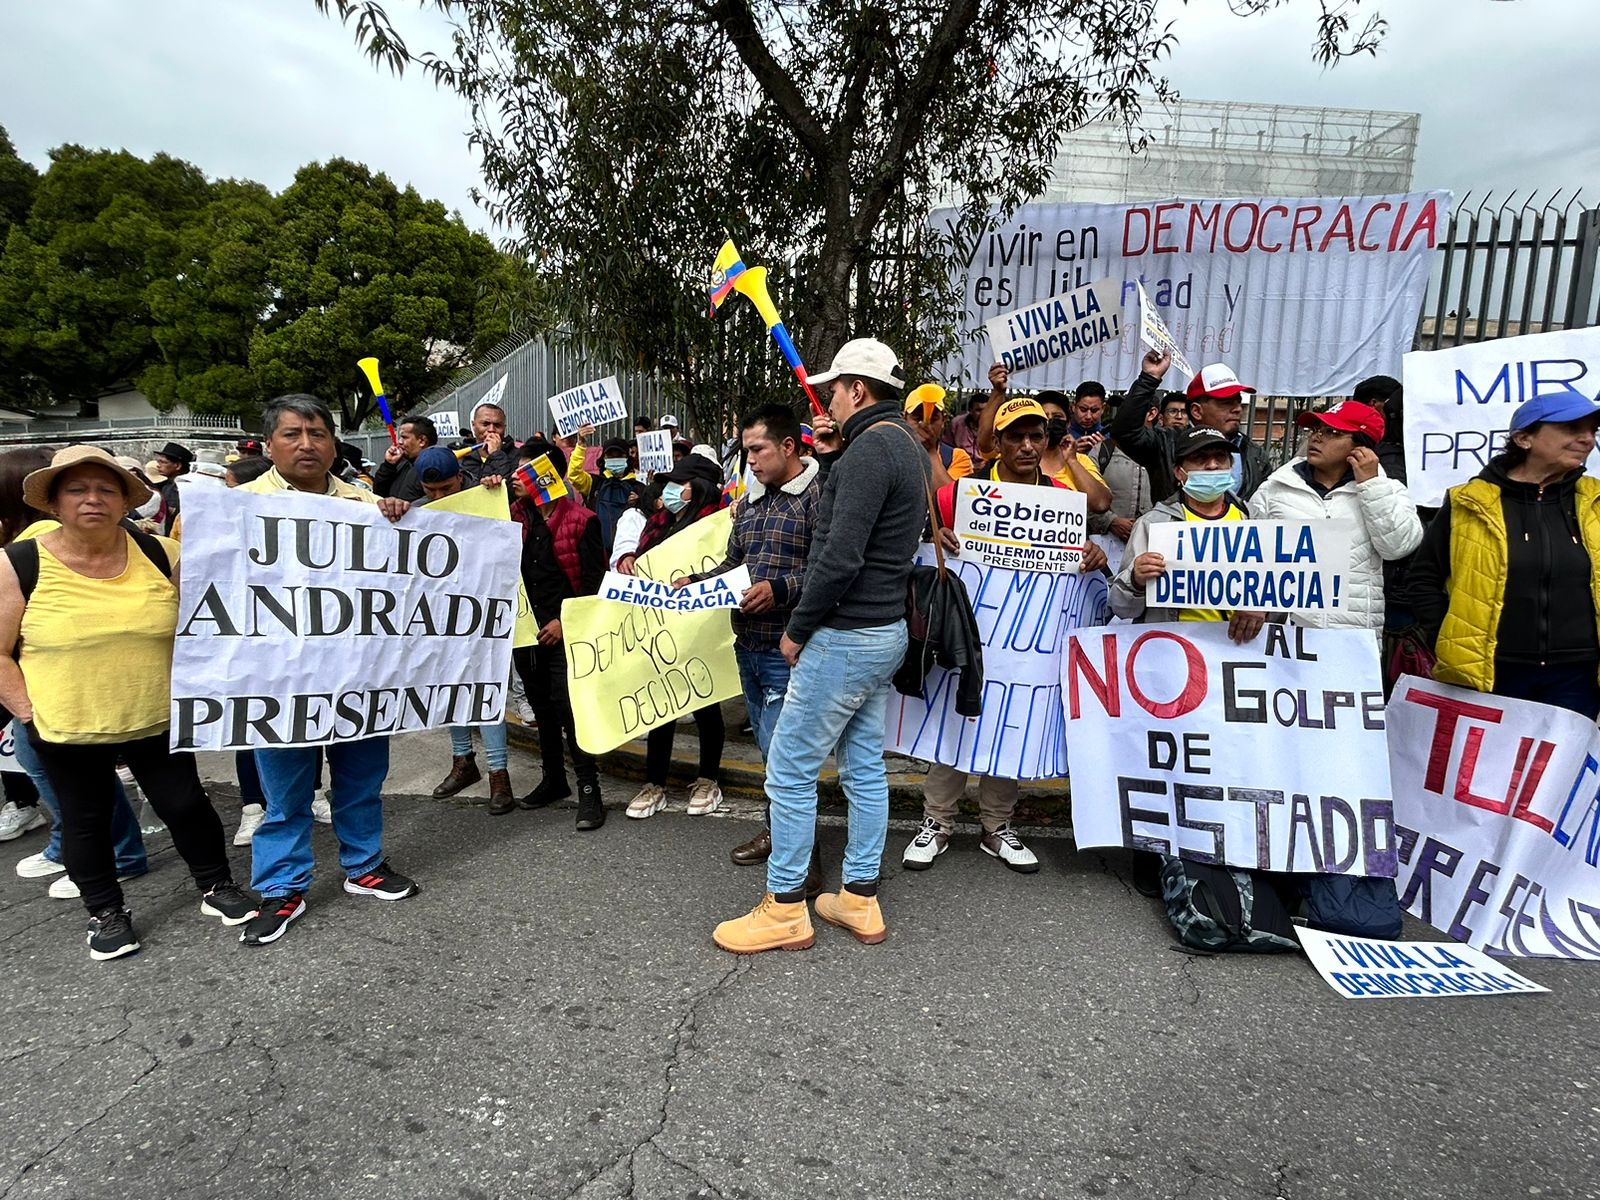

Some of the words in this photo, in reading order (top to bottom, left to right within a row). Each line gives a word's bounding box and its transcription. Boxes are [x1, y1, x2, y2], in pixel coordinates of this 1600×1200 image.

[946, 217, 1042, 268] Vivir
[1056, 226, 1098, 261] en
[1122, 199, 1436, 257] DEMOCRACIA
[974, 276, 1013, 306] es
[1050, 266, 1192, 309] lirtad
[1223, 283, 1242, 321] y
[1008, 299, 1068, 342] ¡VIVA
[1071, 288, 1101, 318] LA
[590, 382, 609, 402] LA
[440, 413, 451, 425] LA
[653, 433, 665, 452] LA
[968, 519, 991, 532] del
[993, 520, 1082, 545] Ecuador
[971, 498, 1083, 526] Gobierno
[248, 514, 459, 578] JULIO
[965, 540, 1045, 560] GUILLERMO
[1049, 550, 1080, 563] LASSO
[982, 554, 1066, 572] PRESIDENTE
[1176, 526, 1263, 563] ¡VIVA
[1275, 525, 1316, 563] LA
[606, 588, 738, 610] DEMOCRACIA
[700, 578, 728, 595] LA
[177, 582, 513, 639] ANDRADE
[641, 629, 678, 674] YO
[1068, 629, 1208, 719] NO
[1265, 624, 1318, 661] AL
[172, 682, 502, 749] PRESENTE
[619, 656, 714, 734] DECIDO
[1222, 661, 1385, 730] GOLPE
[1147, 730, 1211, 774] DE
[1117, 776, 1399, 877] ESTADO
[1325, 939, 1426, 969] ¡VIVA
[1411, 945, 1476, 969] LA
